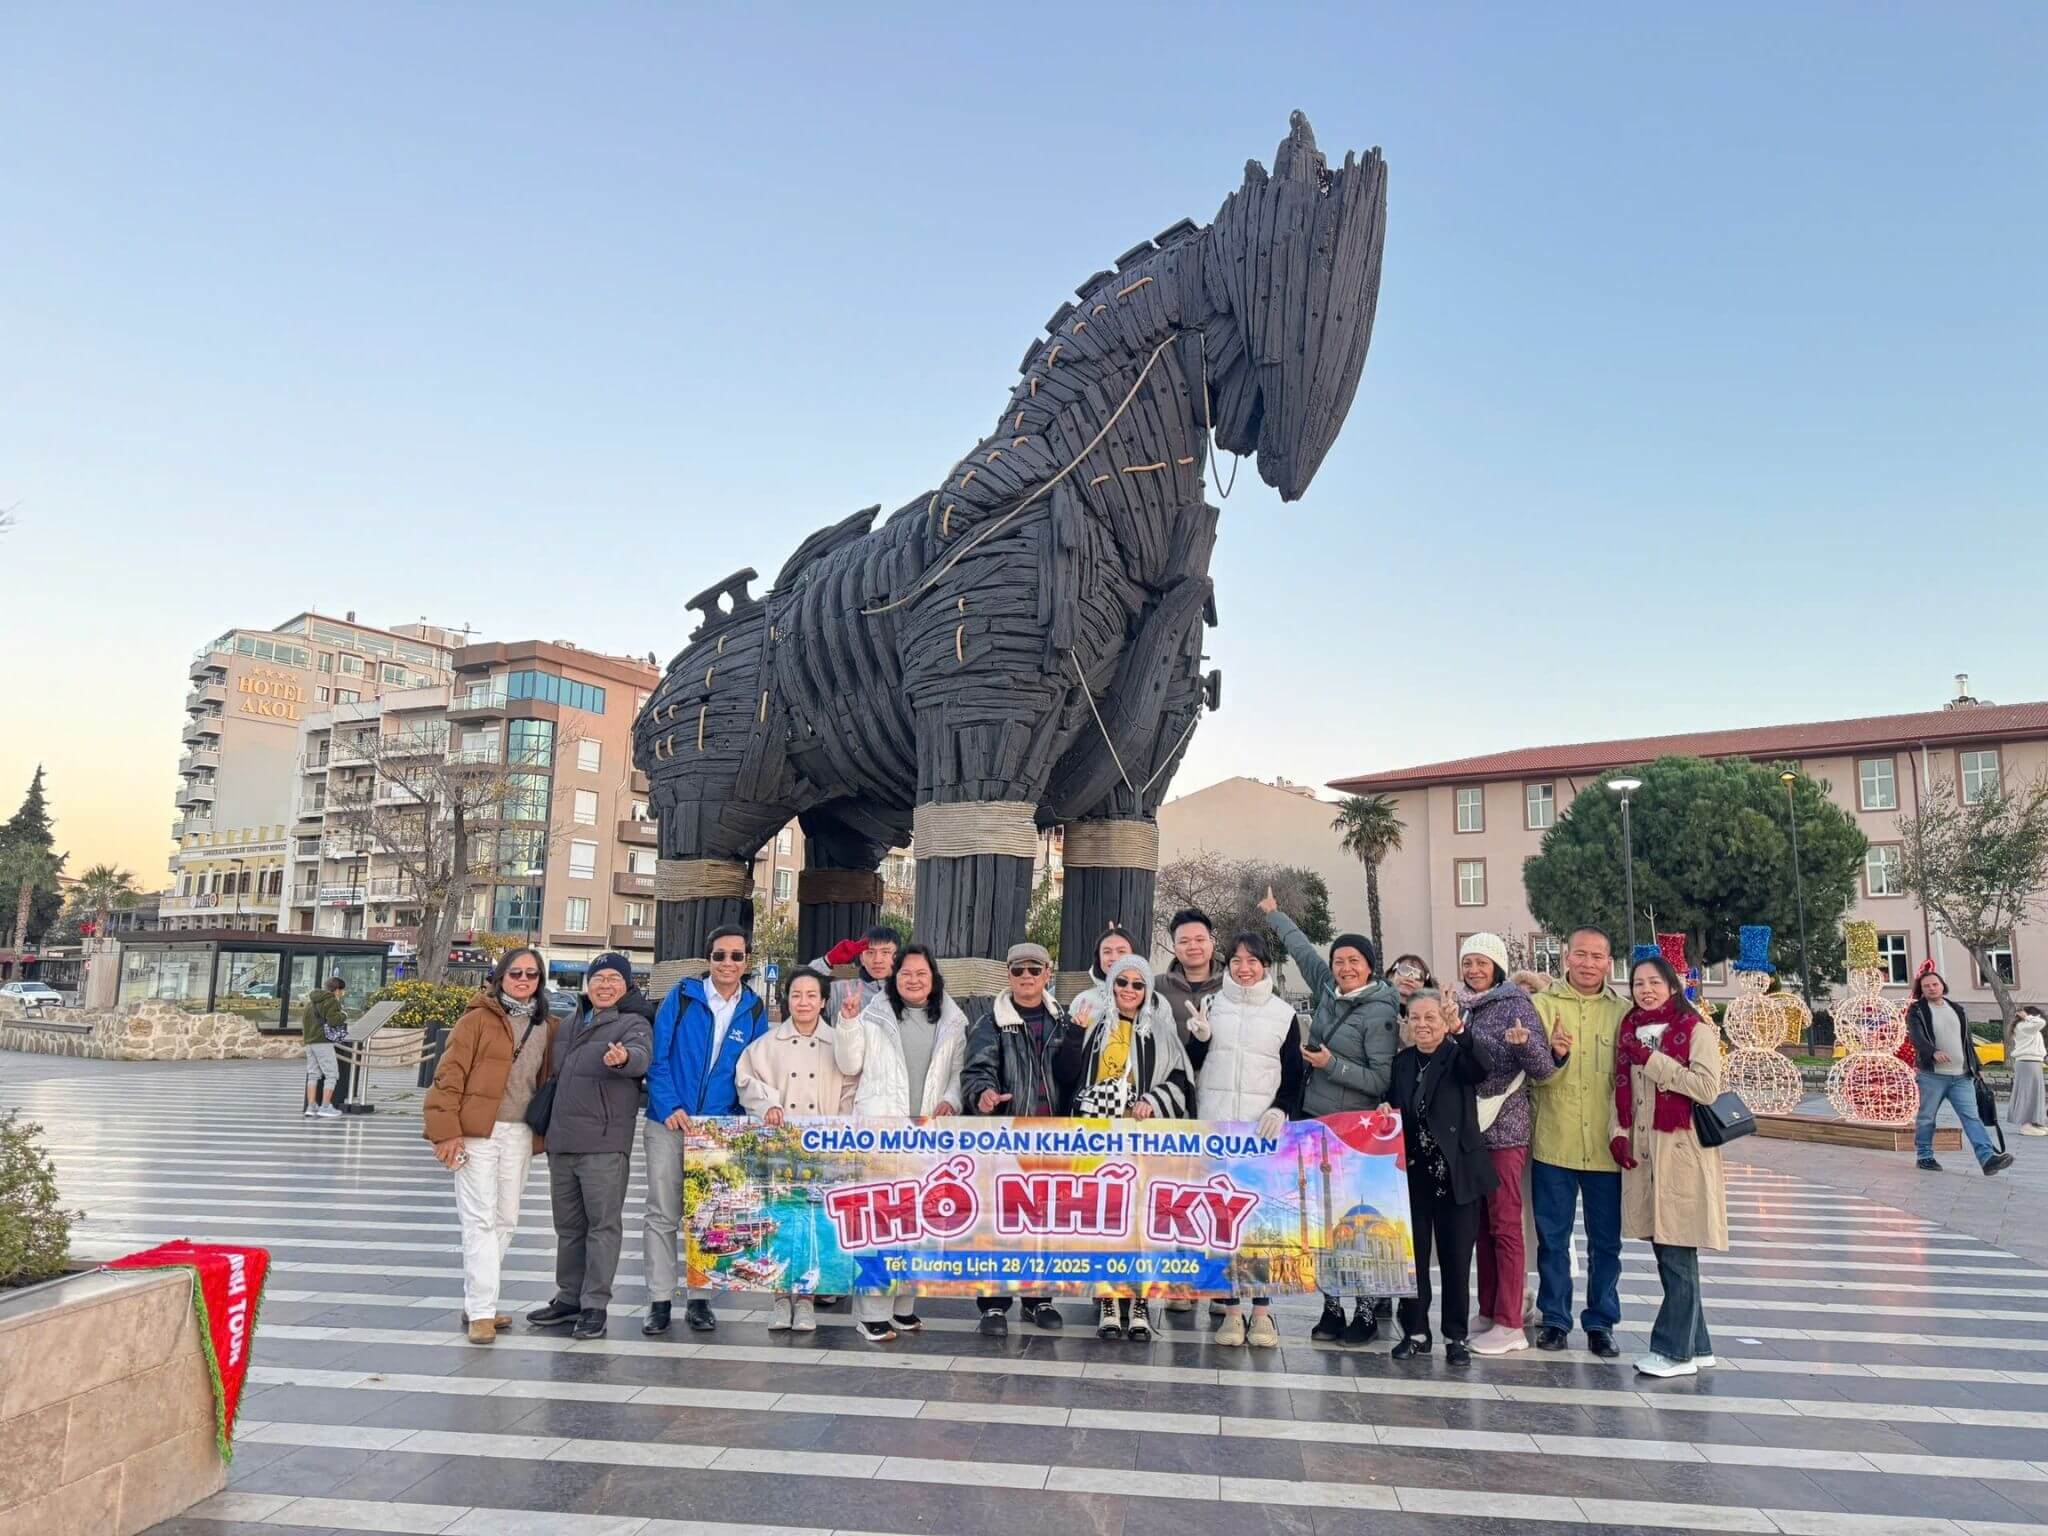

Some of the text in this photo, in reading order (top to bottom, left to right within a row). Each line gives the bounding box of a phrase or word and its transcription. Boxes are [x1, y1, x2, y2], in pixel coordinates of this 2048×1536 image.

[238, 676, 307, 703] HOTEL
[240, 697, 300, 720] AKOL
[803, 1126, 1277, 1156] CHÀO MỪNG ĐOÀN KHÁCH THAM QUAN
[825, 1155, 1258, 1250] THỔ NHĨ KỲ
[883, 1256, 907, 1271] Tết
[912, 1257, 962, 1275] Dương
[967, 1257, 997, 1275] Lịch
[1002, 1257, 1090, 1273] 28/12/2025
[1107, 1257, 1200, 1274] 06/01/2026
